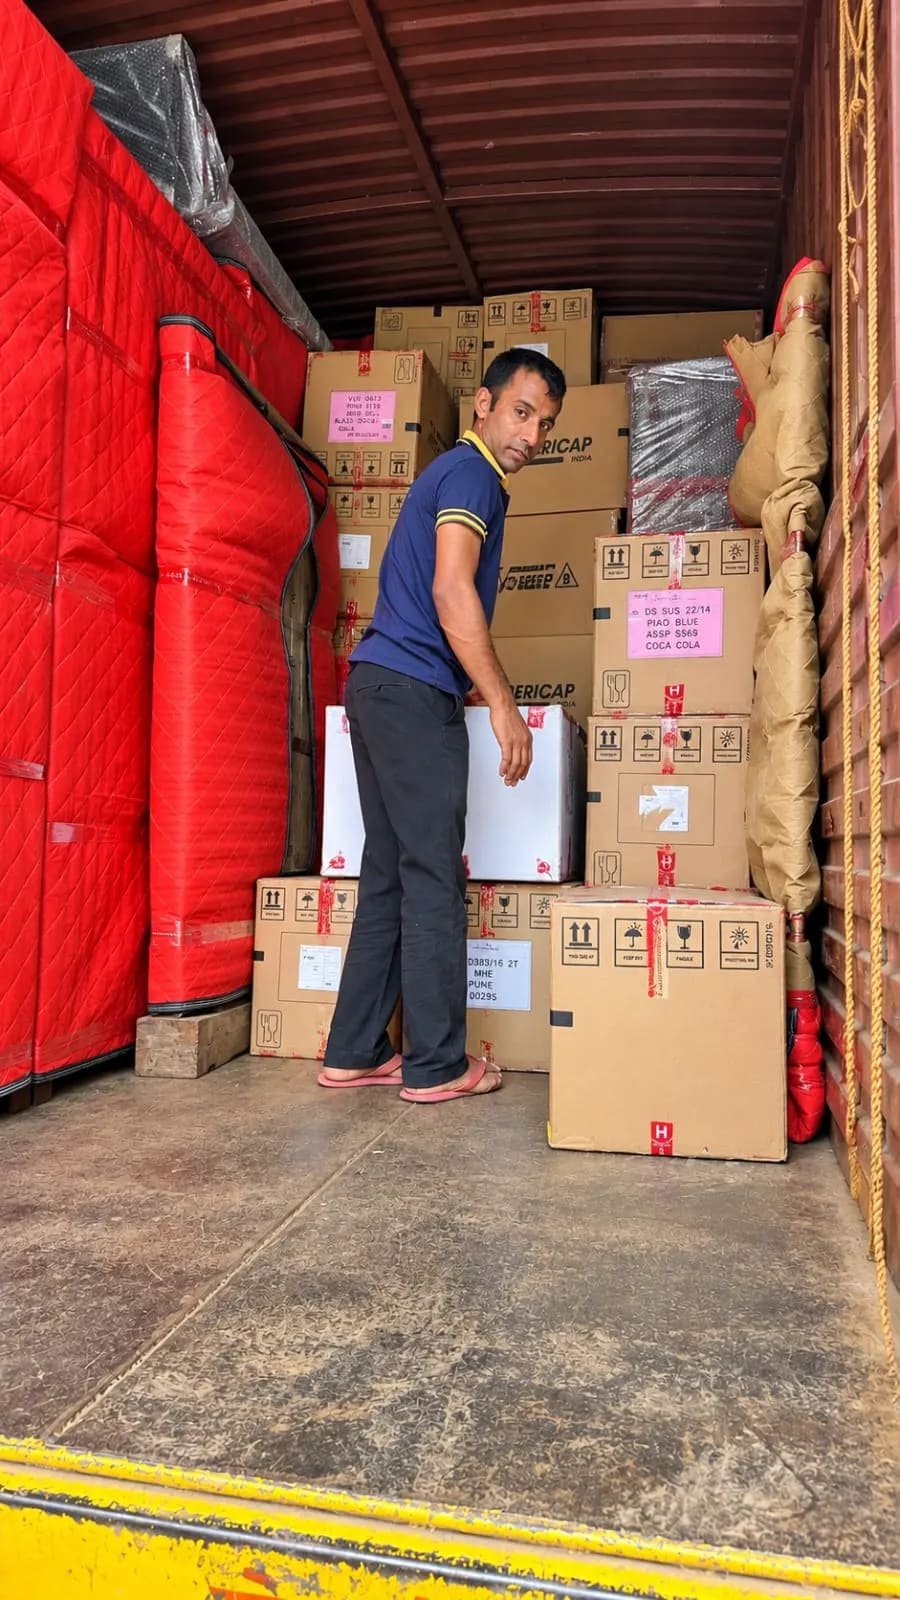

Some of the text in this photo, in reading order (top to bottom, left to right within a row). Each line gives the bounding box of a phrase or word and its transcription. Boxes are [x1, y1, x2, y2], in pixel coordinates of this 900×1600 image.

[571, 455, 592, 463] INDIA
[644, 607, 657, 616] DS
[661, 606, 681, 616] SUS
[685, 605, 711, 615] 22/14
[675, 617, 699, 627] BLUE
[646, 630, 671, 639] ASSP
[645, 640, 701, 650] COCA COLA
[507, 959, 519, 968] 2T
[473, 969, 494, 978] MHE
[468, 980, 494, 990] PUNE
[655, 1124, 668, 1139] H
